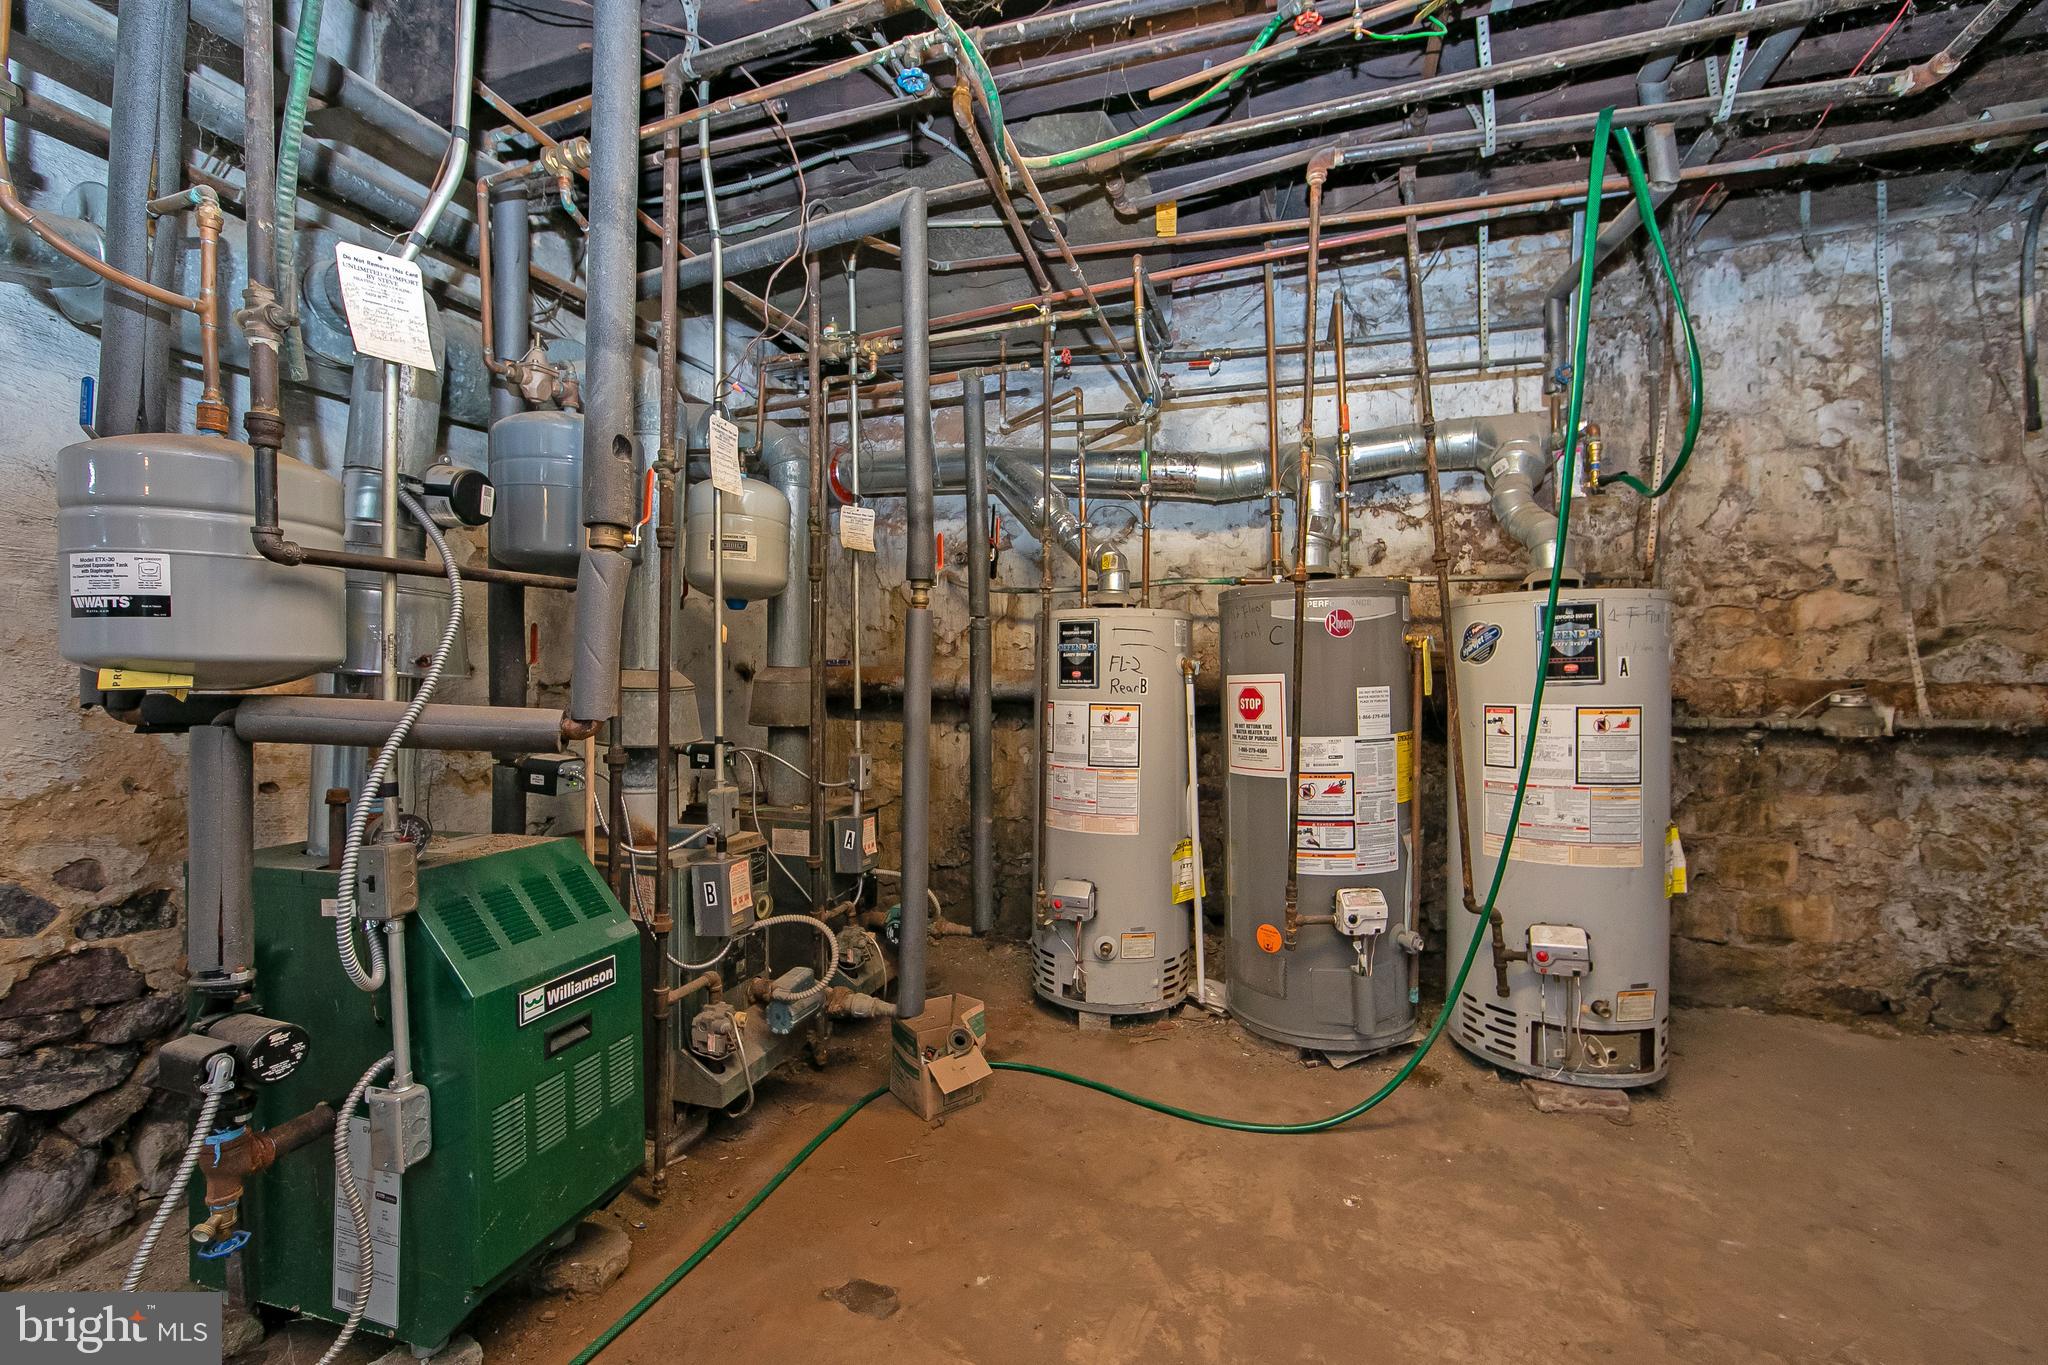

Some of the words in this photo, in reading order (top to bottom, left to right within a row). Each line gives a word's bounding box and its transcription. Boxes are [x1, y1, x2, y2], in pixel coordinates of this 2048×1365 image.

[1328, 610, 1353, 633] Rheem
[1058, 643, 1097, 651] DEFENDER
[1620, 658, 1628, 676] A
[1110, 678, 1139, 694] Rear
[1141, 679, 1147, 694] B
[1240, 698, 1261, 710] STOP
[846, 832, 853, 848] A
[705, 884, 715, 904] B
[547, 968, 613, 1005] Williamson
